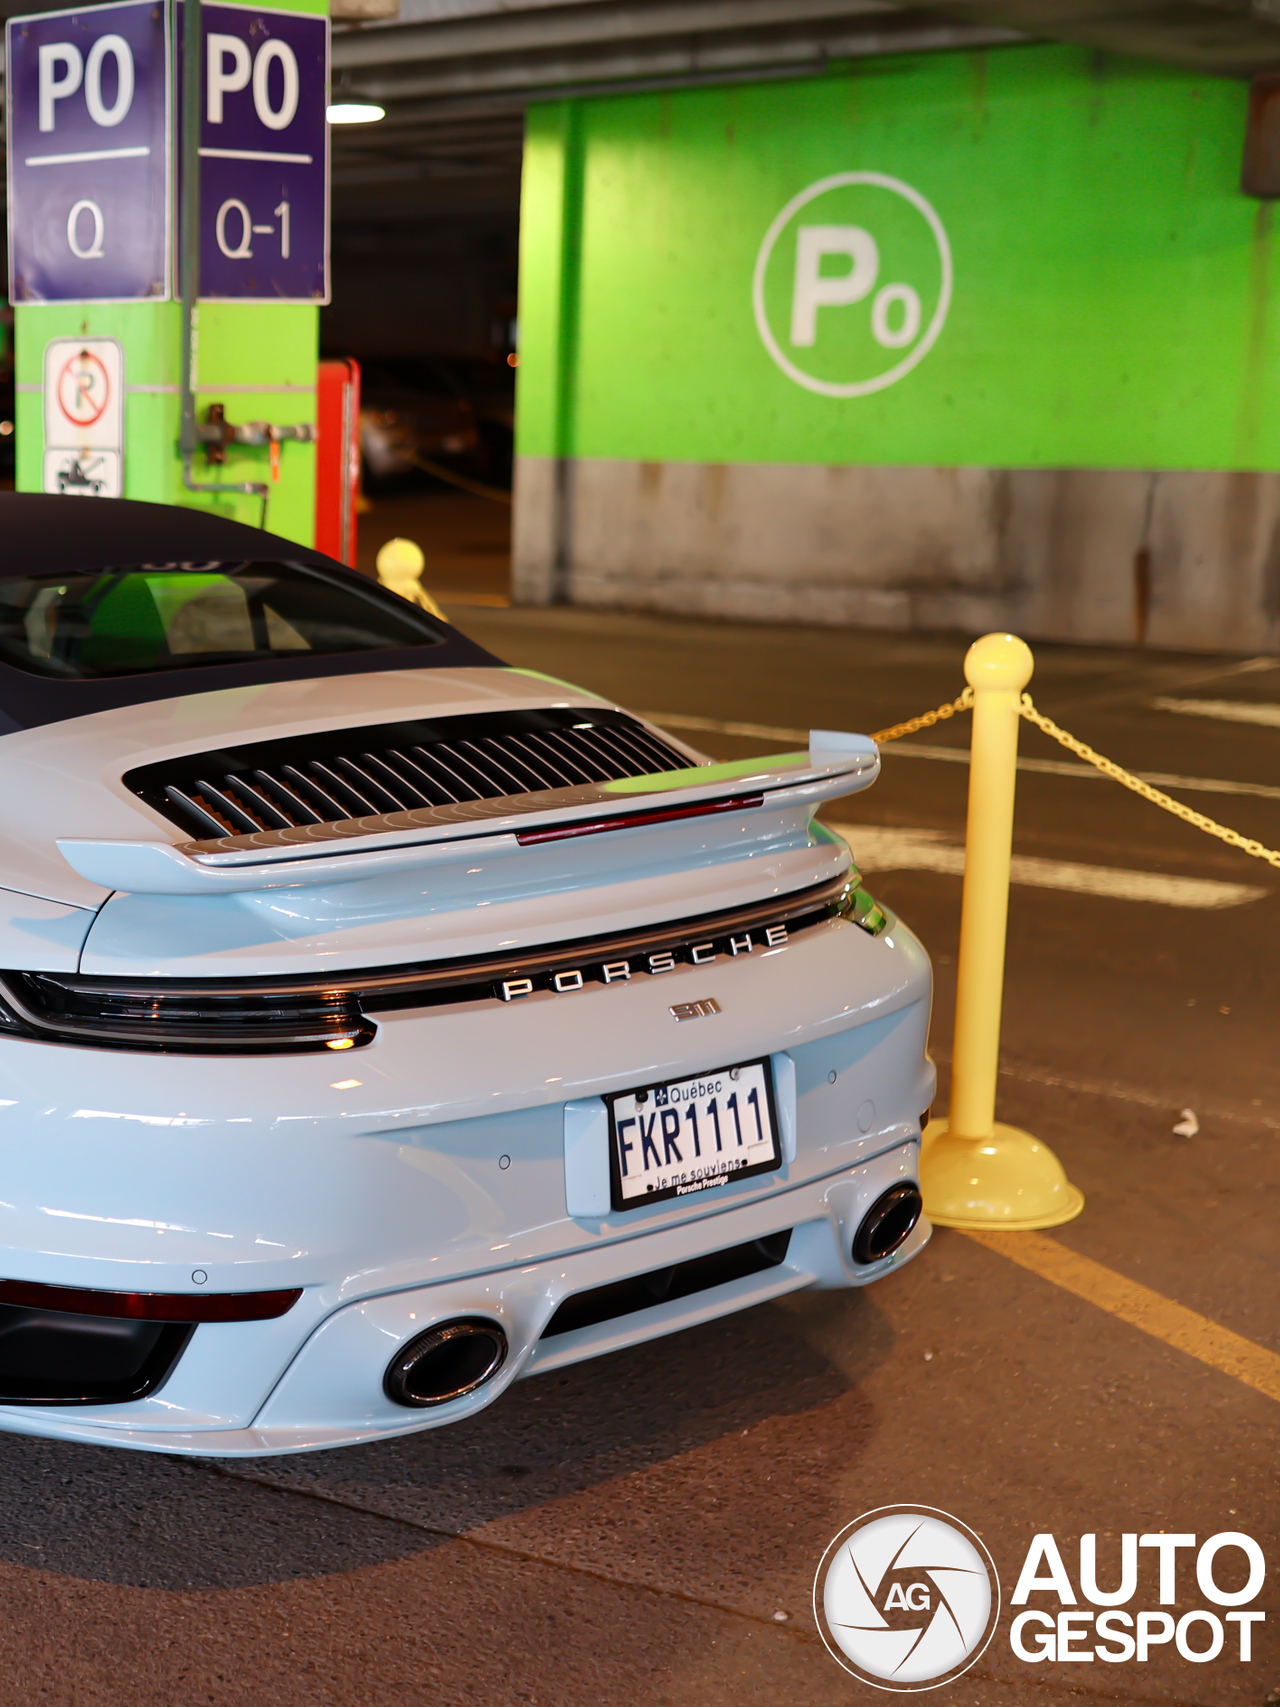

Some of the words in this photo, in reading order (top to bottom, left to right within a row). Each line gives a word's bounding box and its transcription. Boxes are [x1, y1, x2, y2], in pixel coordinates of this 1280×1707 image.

[67, 198, 104, 259] Q
[216, 198, 290, 259] Q-1
[502, 924, 789, 1002] PORSCHE
[668, 997, 721, 1023] 911
[670, 1080, 723, 1104] Québec
[617, 1086, 765, 1178] FKR1111
[655, 1175, 668, 1190] Je
[671, 1172, 687, 1186] me
[690, 1158, 741, 1181] souviens
[676, 1180, 703, 1196] Porsche
[702, 1174, 729, 1188] Prestige
